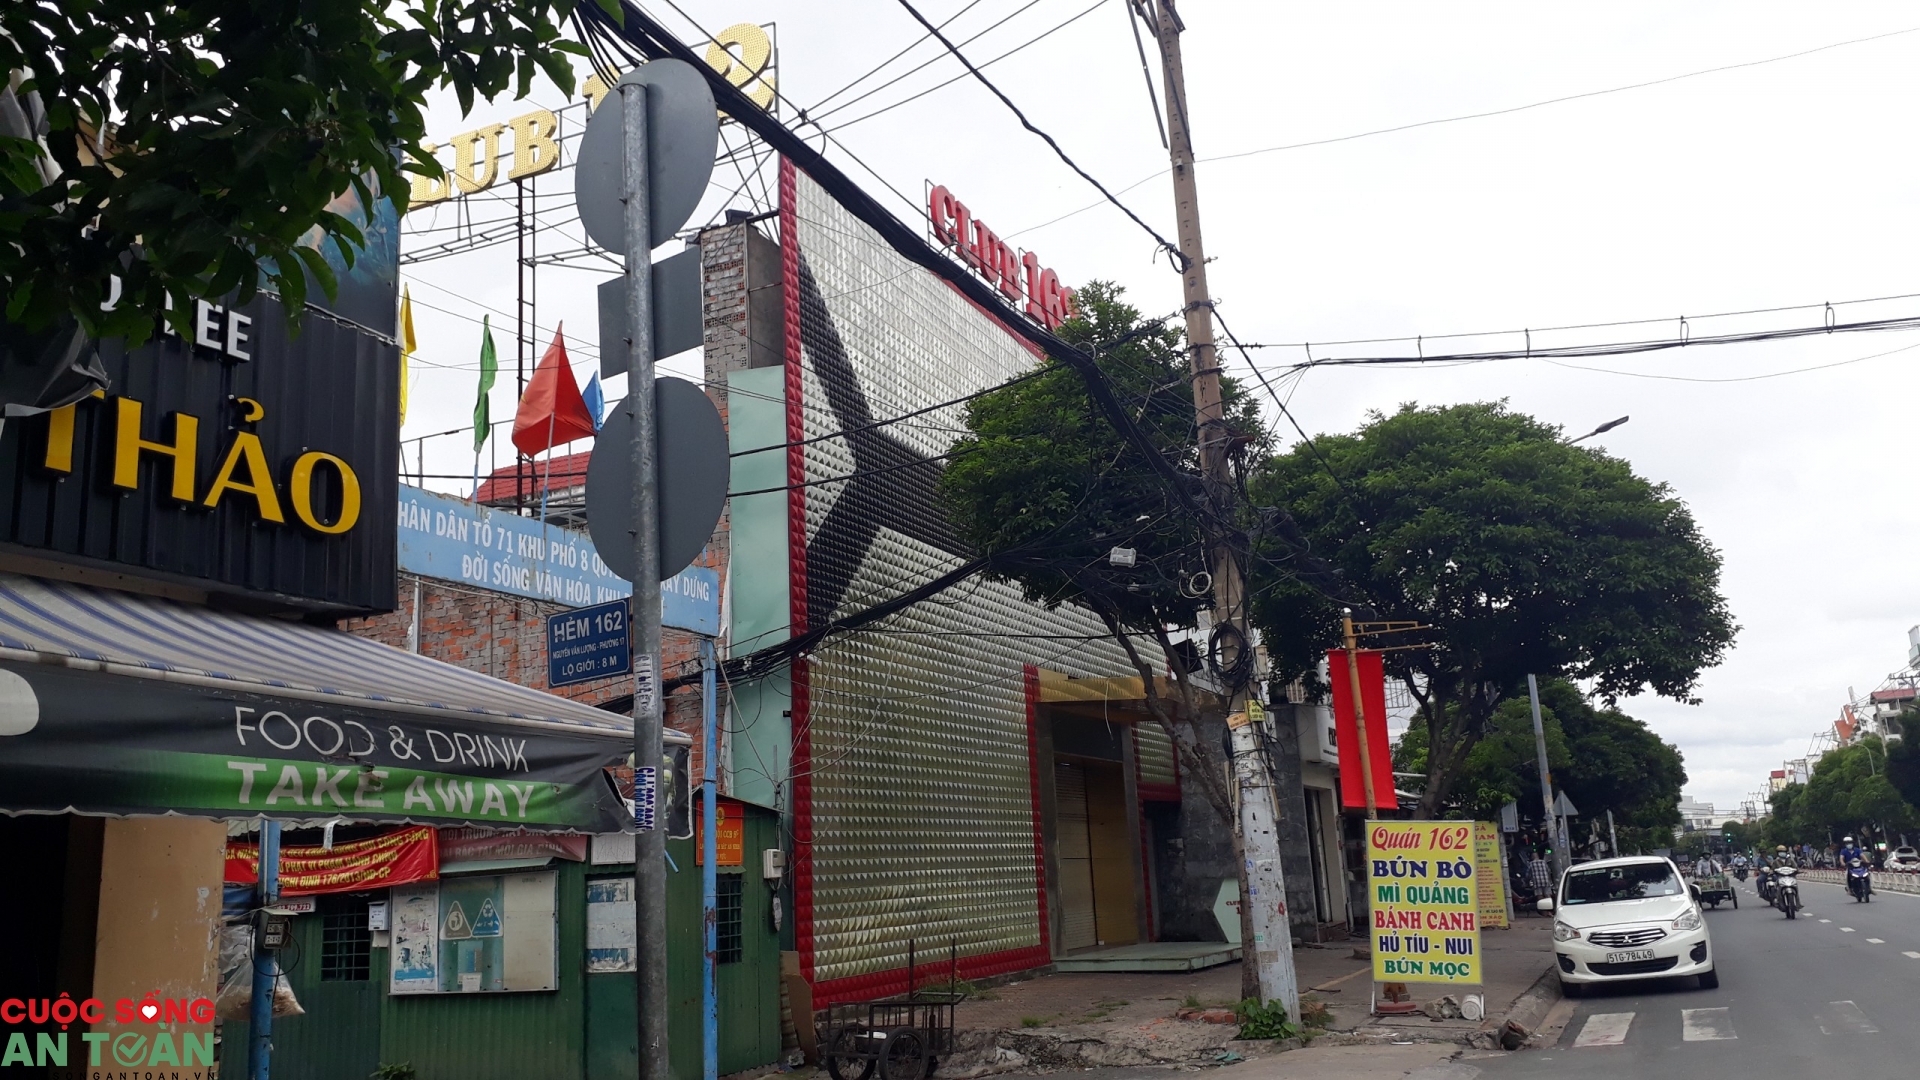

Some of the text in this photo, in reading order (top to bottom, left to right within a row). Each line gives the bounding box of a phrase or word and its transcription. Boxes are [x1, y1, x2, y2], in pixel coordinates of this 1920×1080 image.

[930, 185, 1023, 301] CLUB
[397, 498, 430, 534] HÂN
[436, 509, 468, 542] DÂN
[473, 512, 493, 548] TỔ
[497, 527, 514, 553] 71
[518, 533, 546, 561] KHU
[550, 537, 577, 569] PHỐ
[580, 549, 589, 572] 8
[683, 575, 709, 603] DỰNG
[462, 551, 488, 583] ĐỜI
[493, 555, 530, 593] SỐNG
[536, 569, 562, 598] VĂN
[566, 576, 591, 605] HÓA
[553, 610, 623, 643] HẺM 162
[576, 658, 595, 673] GIỚI
[602, 657, 608, 668] 8
[609, 655, 617, 667] M
[234, 706, 529, 773] FOOD & DRINK
[227, 761, 535, 818] TAKE AWAY
[1371, 826, 1469, 851] Quán 162
[1372, 856, 1472, 879] BÚN BÒ
[1378, 882, 1401, 903] MÌ
[1406, 881, 1469, 905] QUẢNG
[1374, 906, 1475, 931] BÁNH CANH
[1379, 931, 1400, 953] HỦ
[1404, 933, 1429, 954] TÍU
[1445, 937, 1473, 955] NUI
[1384, 957, 1470, 979] BÚN MỌC
[1608, 950, 1653, 963] 51G-784.49
